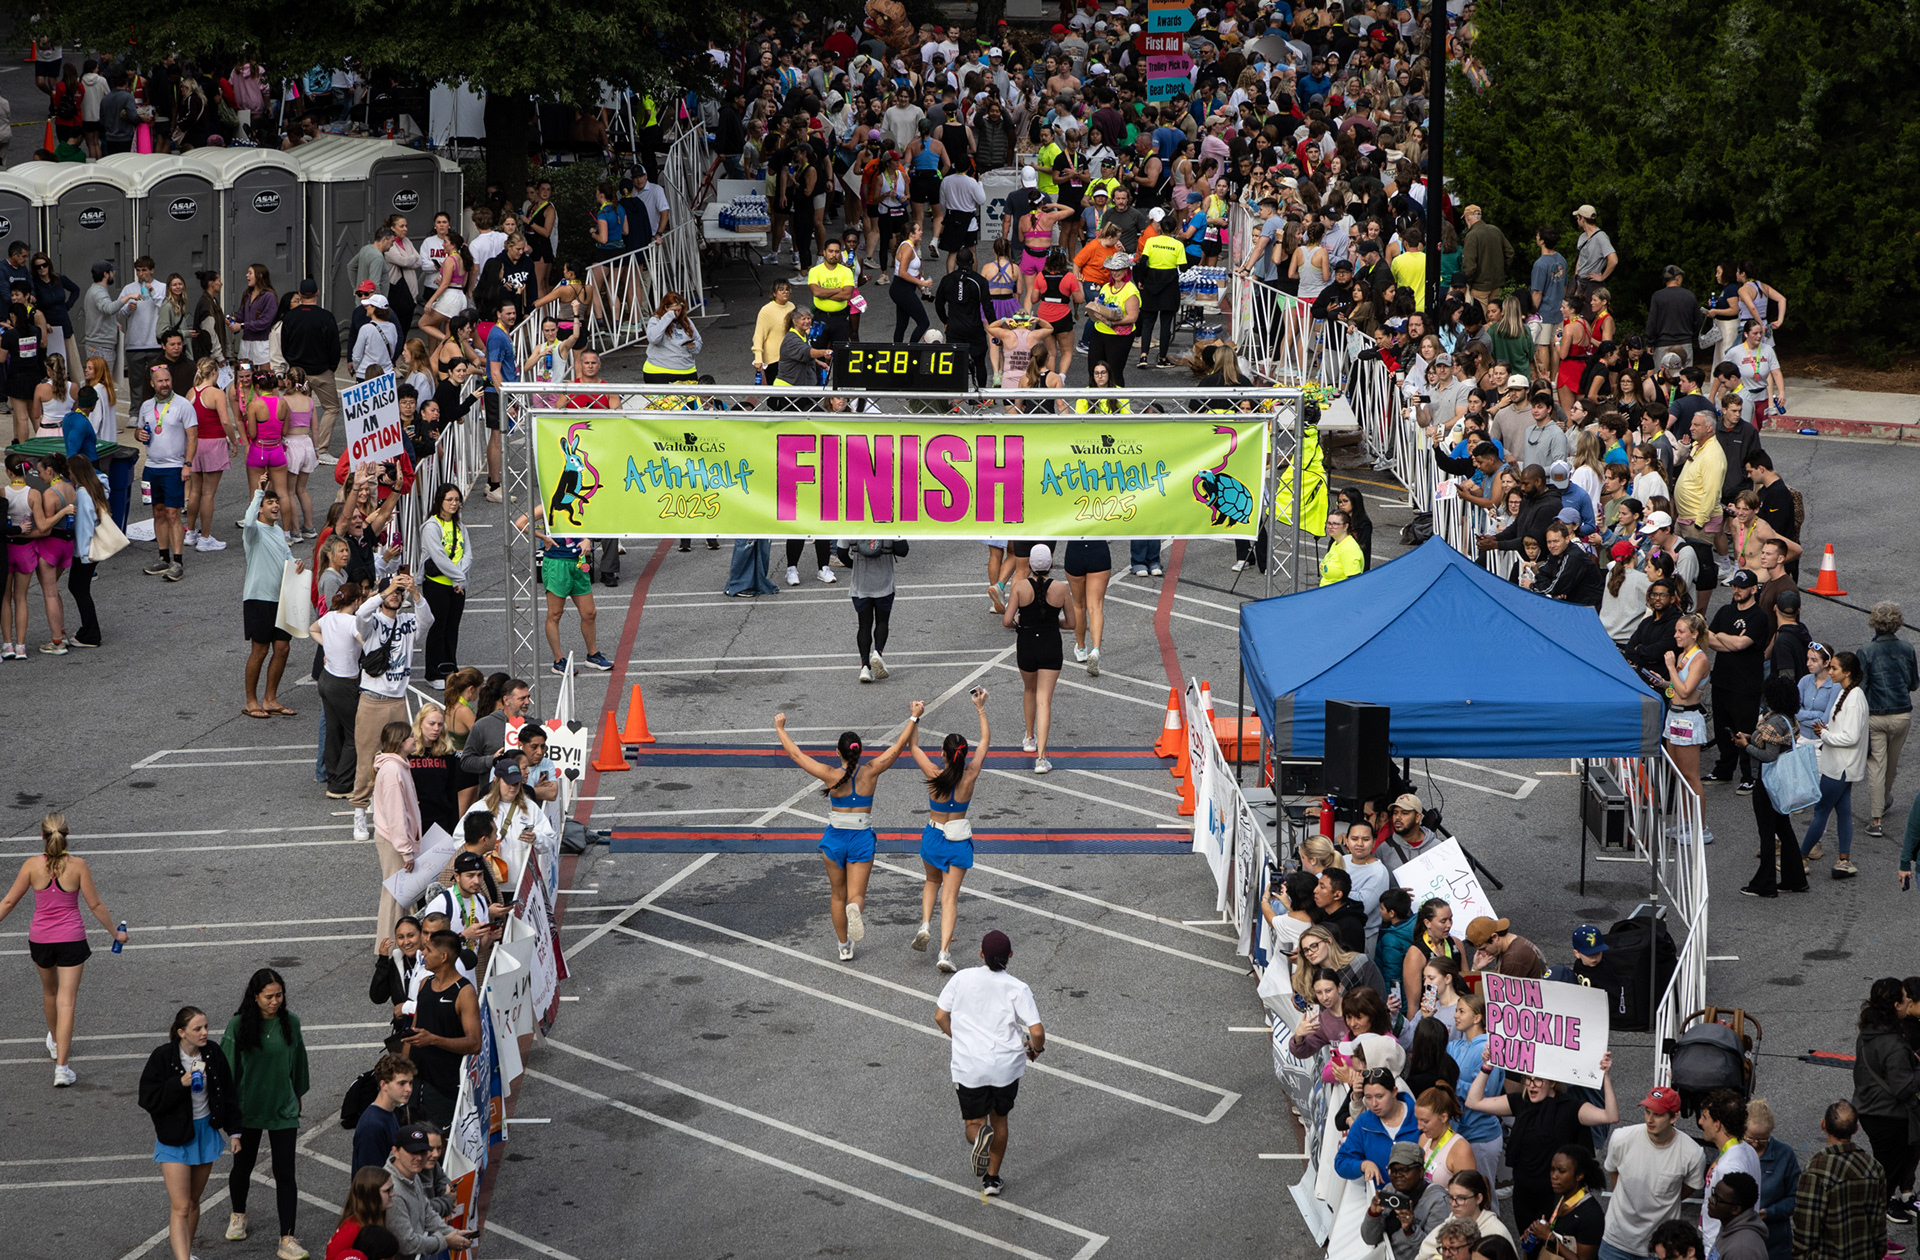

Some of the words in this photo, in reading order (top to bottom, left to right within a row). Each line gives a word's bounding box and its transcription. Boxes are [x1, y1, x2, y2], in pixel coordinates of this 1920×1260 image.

[1157, 15, 1182, 27] Awards
[1145, 37, 1164, 50] First
[1165, 38, 1179, 51] Aid
[1148, 62, 1167, 72] Trolley
[1168, 61, 1180, 70] Pick
[1181, 60, 1190, 70] Up
[1149, 85, 1164, 96] Gear
[1165, 83, 1186, 95] Check
[255, 195, 278, 204] ASAP
[394, 193, 417, 201] ASAP
[171, 202, 195, 212] ASAP
[80, 211, 104, 220] ASAP
[343, 373, 395, 405] THERAPY
[345, 399, 370, 421] WAS
[372, 390, 395, 411] ALSO
[363, 414, 379, 434] AN
[353, 421, 401, 460] OPTION
[653, 442, 698, 452] Walton
[700, 443, 726, 453] GAS
[1070, 445, 1116, 454] Walton
[1117, 445, 1143, 455] GAS
[776, 434, 1025, 523] FINISH
[658, 493, 720, 519] 2025
[1074, 495, 1137, 521] 2025
[506, 730, 519, 746] G
[410, 757, 447, 769] GEORGIA
[1486, 973, 1543, 1009] RUN
[1487, 1002, 1581, 1051] POOKIE
[1489, 1033, 1536, 1074] RUN
